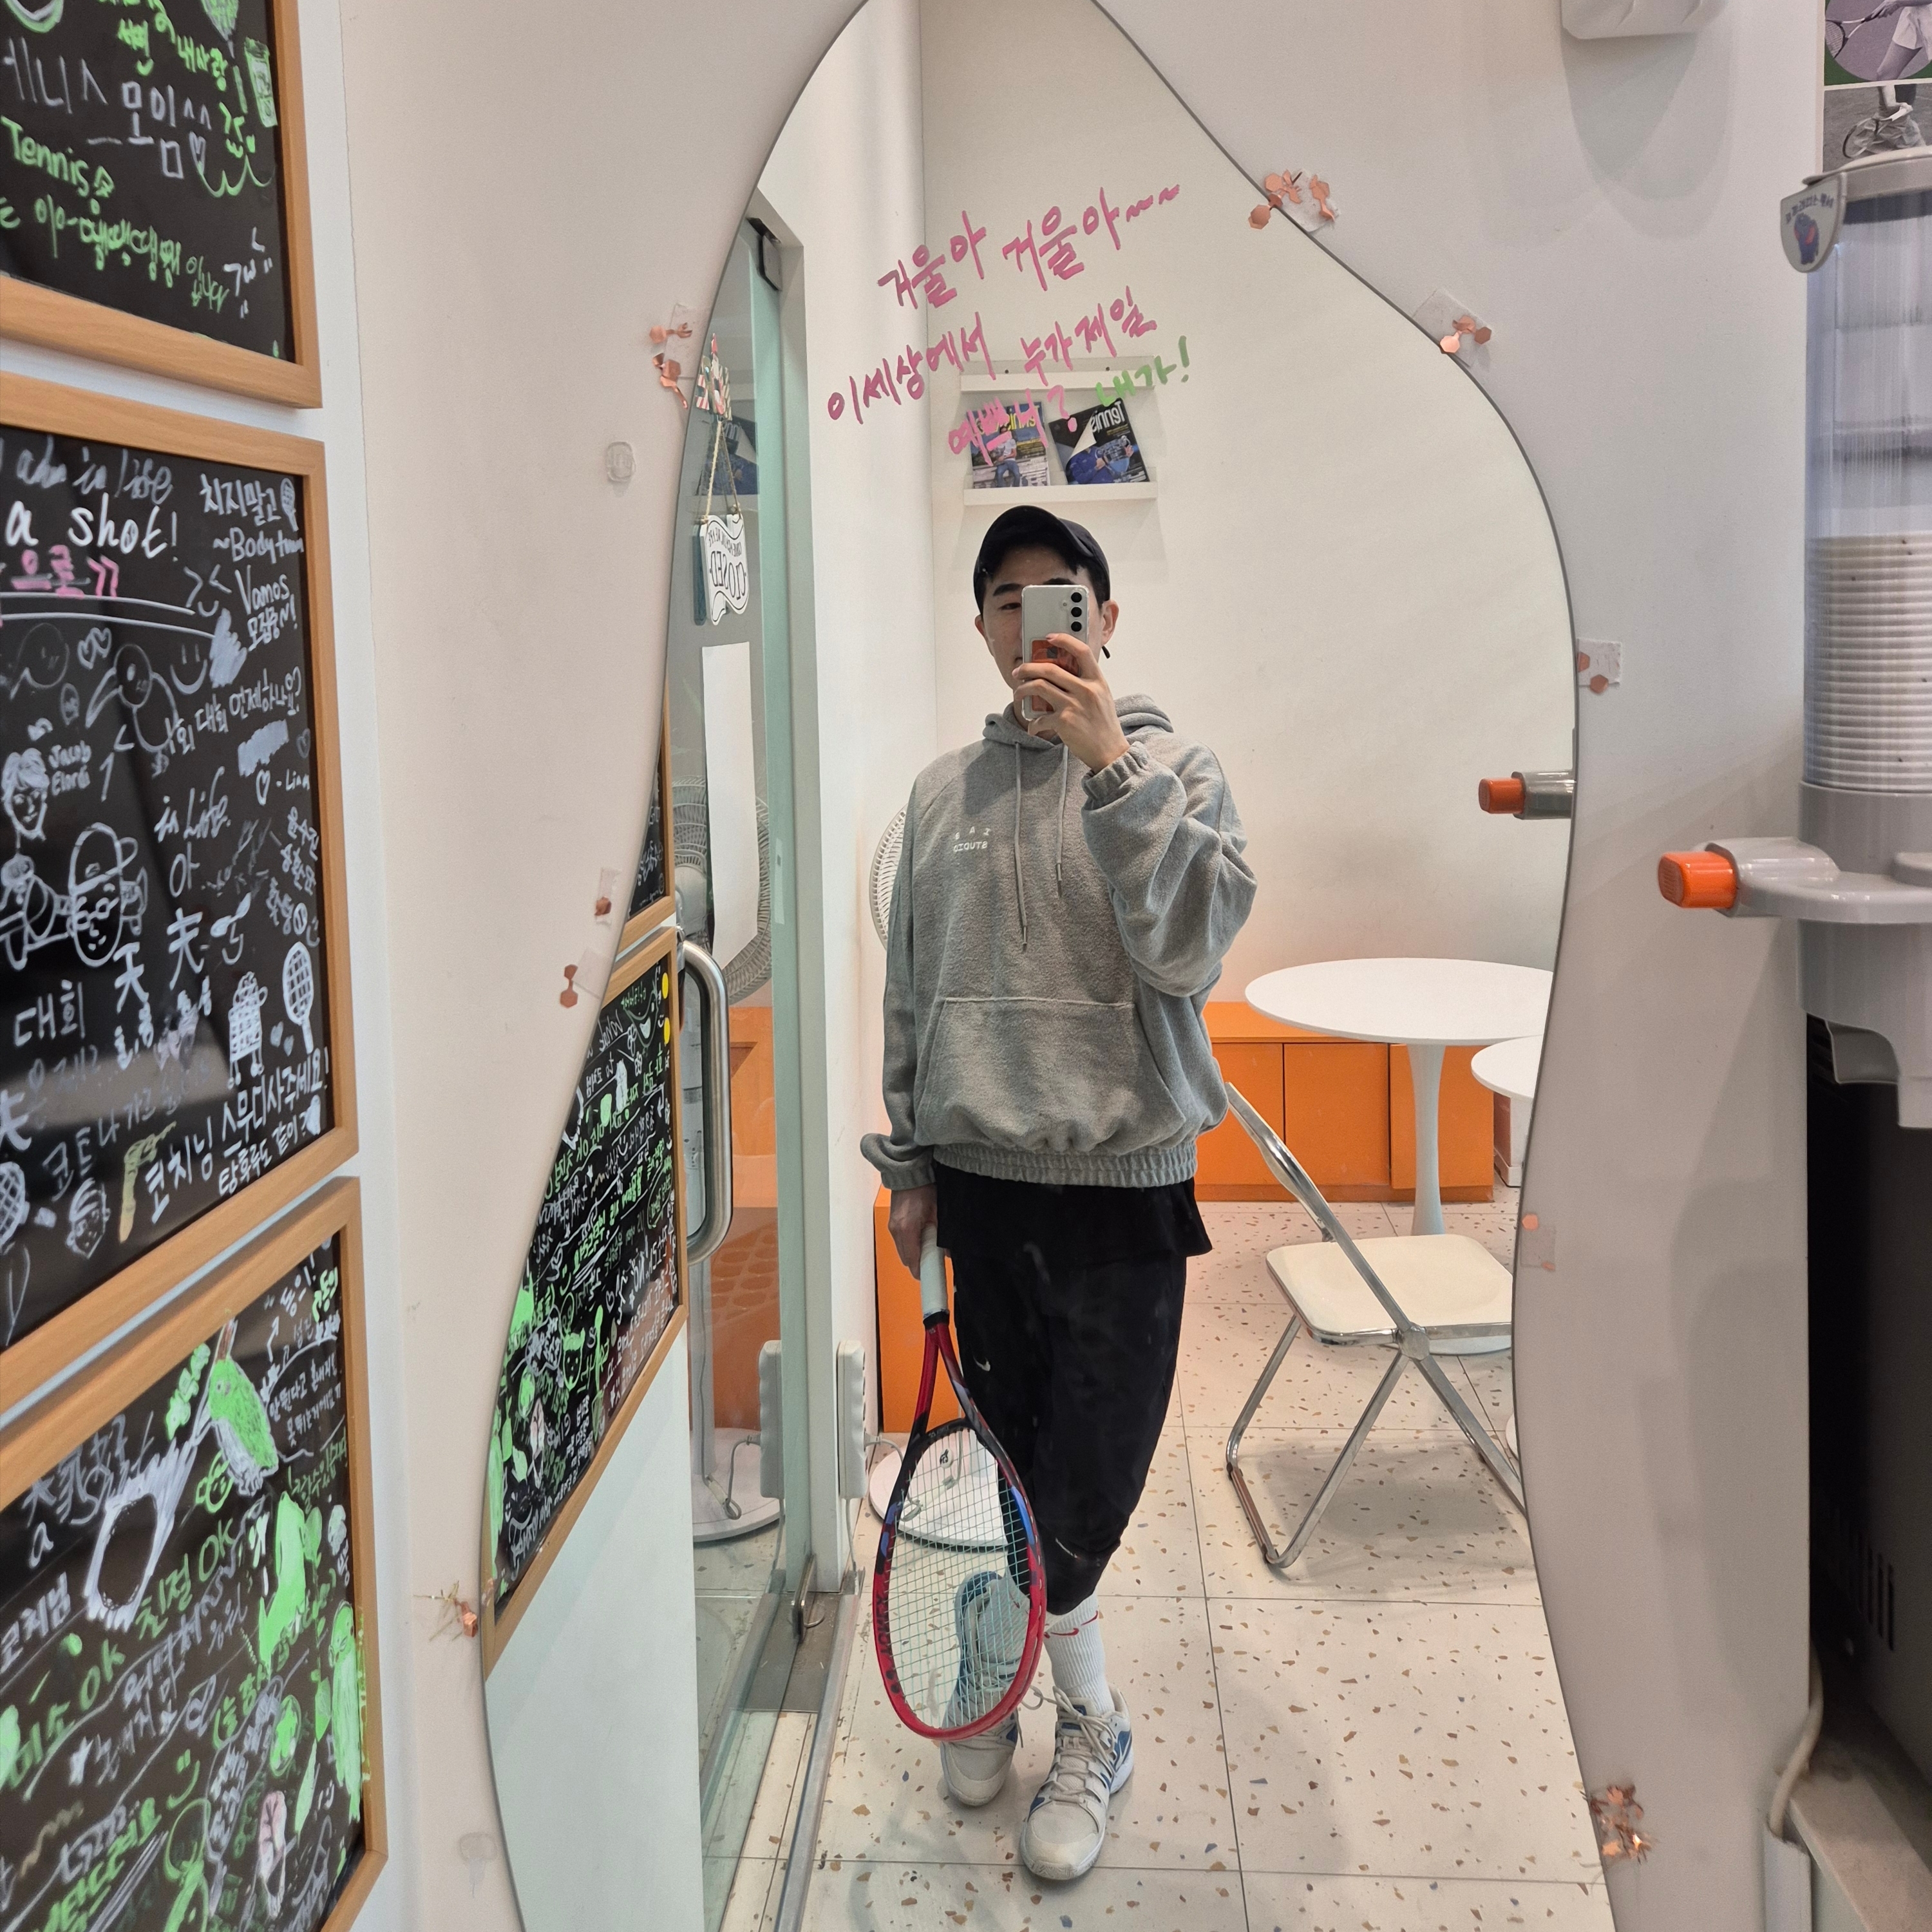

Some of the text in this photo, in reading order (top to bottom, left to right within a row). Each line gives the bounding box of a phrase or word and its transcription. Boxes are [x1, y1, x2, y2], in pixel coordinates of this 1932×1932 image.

[1, 116, 89, 195] Tennis
[878, 211, 987, 309] 거울아
[1095, 335, 1190, 408] 내가!
[5, 492, 178, 562] a shot!
[200, 473, 281, 526] 치지말고
[234, 565, 290, 615] Vamos
[14, 978, 86, 1047] 대회
[135, 1553, 193, 1640] 친절
